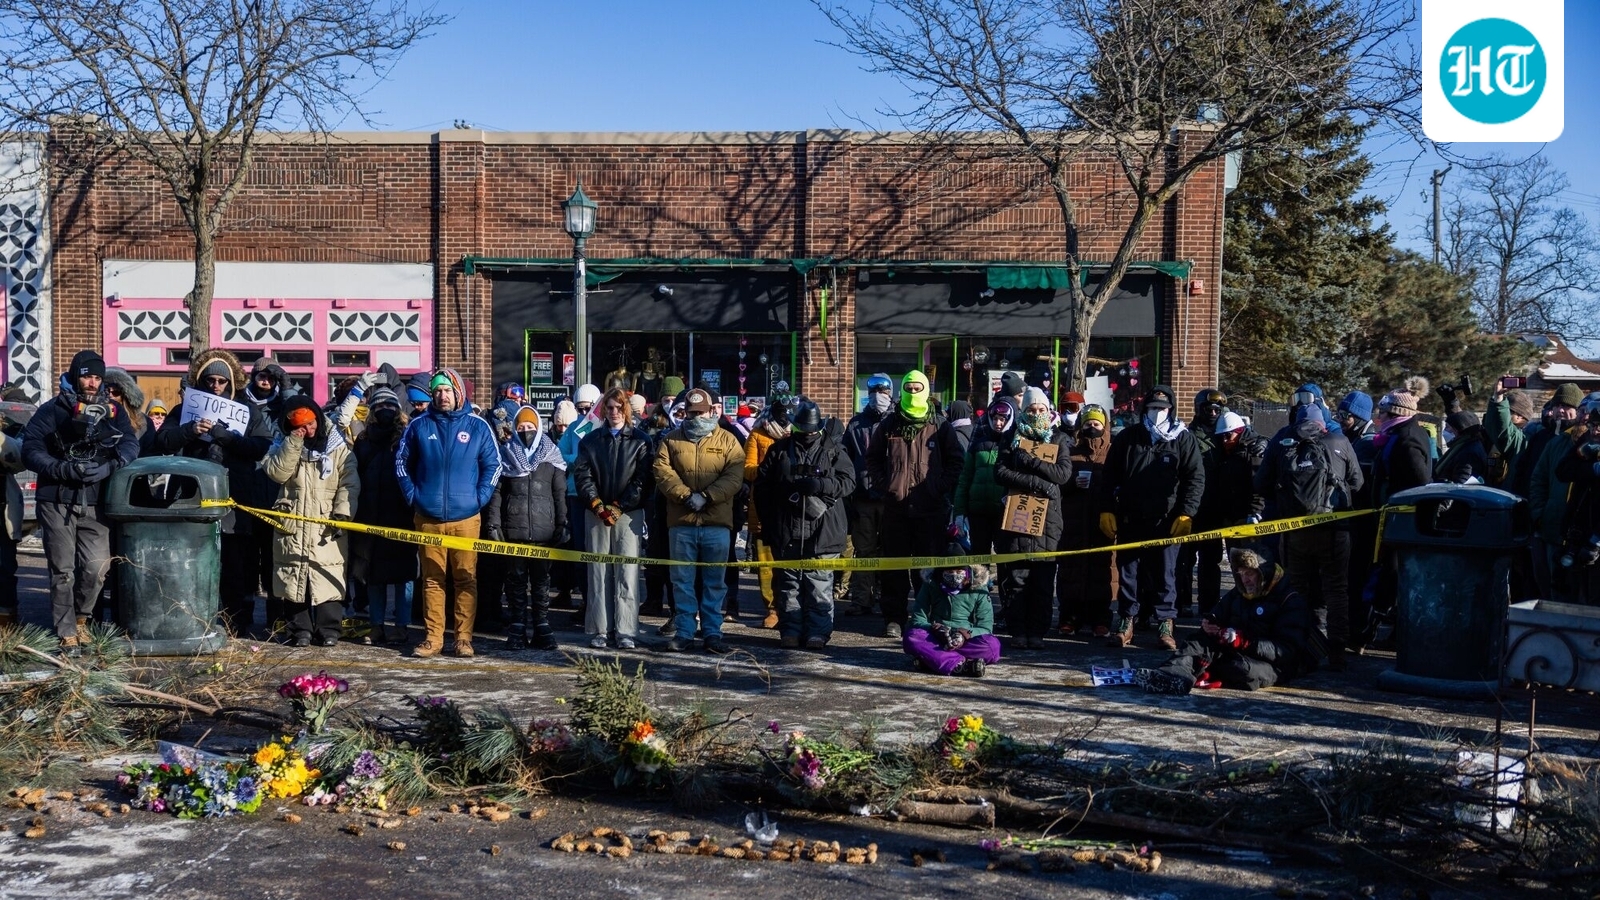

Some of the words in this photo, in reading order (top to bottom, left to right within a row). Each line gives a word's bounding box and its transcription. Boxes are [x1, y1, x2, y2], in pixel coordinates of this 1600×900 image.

[188, 394, 227, 413] STOP
[226, 404, 248, 424] ICE
[1277, 522, 1290, 532] NOT
[1291, 520, 1300, 528] DO
[366, 528, 385, 537] CROSS
[1254, 525, 1276, 534] CROSS
[388, 531, 399, 539] NOT
[400, 532, 408, 540] DO
[410, 533, 422, 543] LINE
[424, 536, 443, 546] POLICE
[473, 542, 492, 552] CROSS
[493, 545, 505, 553] NOT
[506, 546, 515, 554] DO
[516, 547, 529, 556] LINE
[530, 548, 550, 558] POLICE
[581, 554, 600, 562] CROSS
